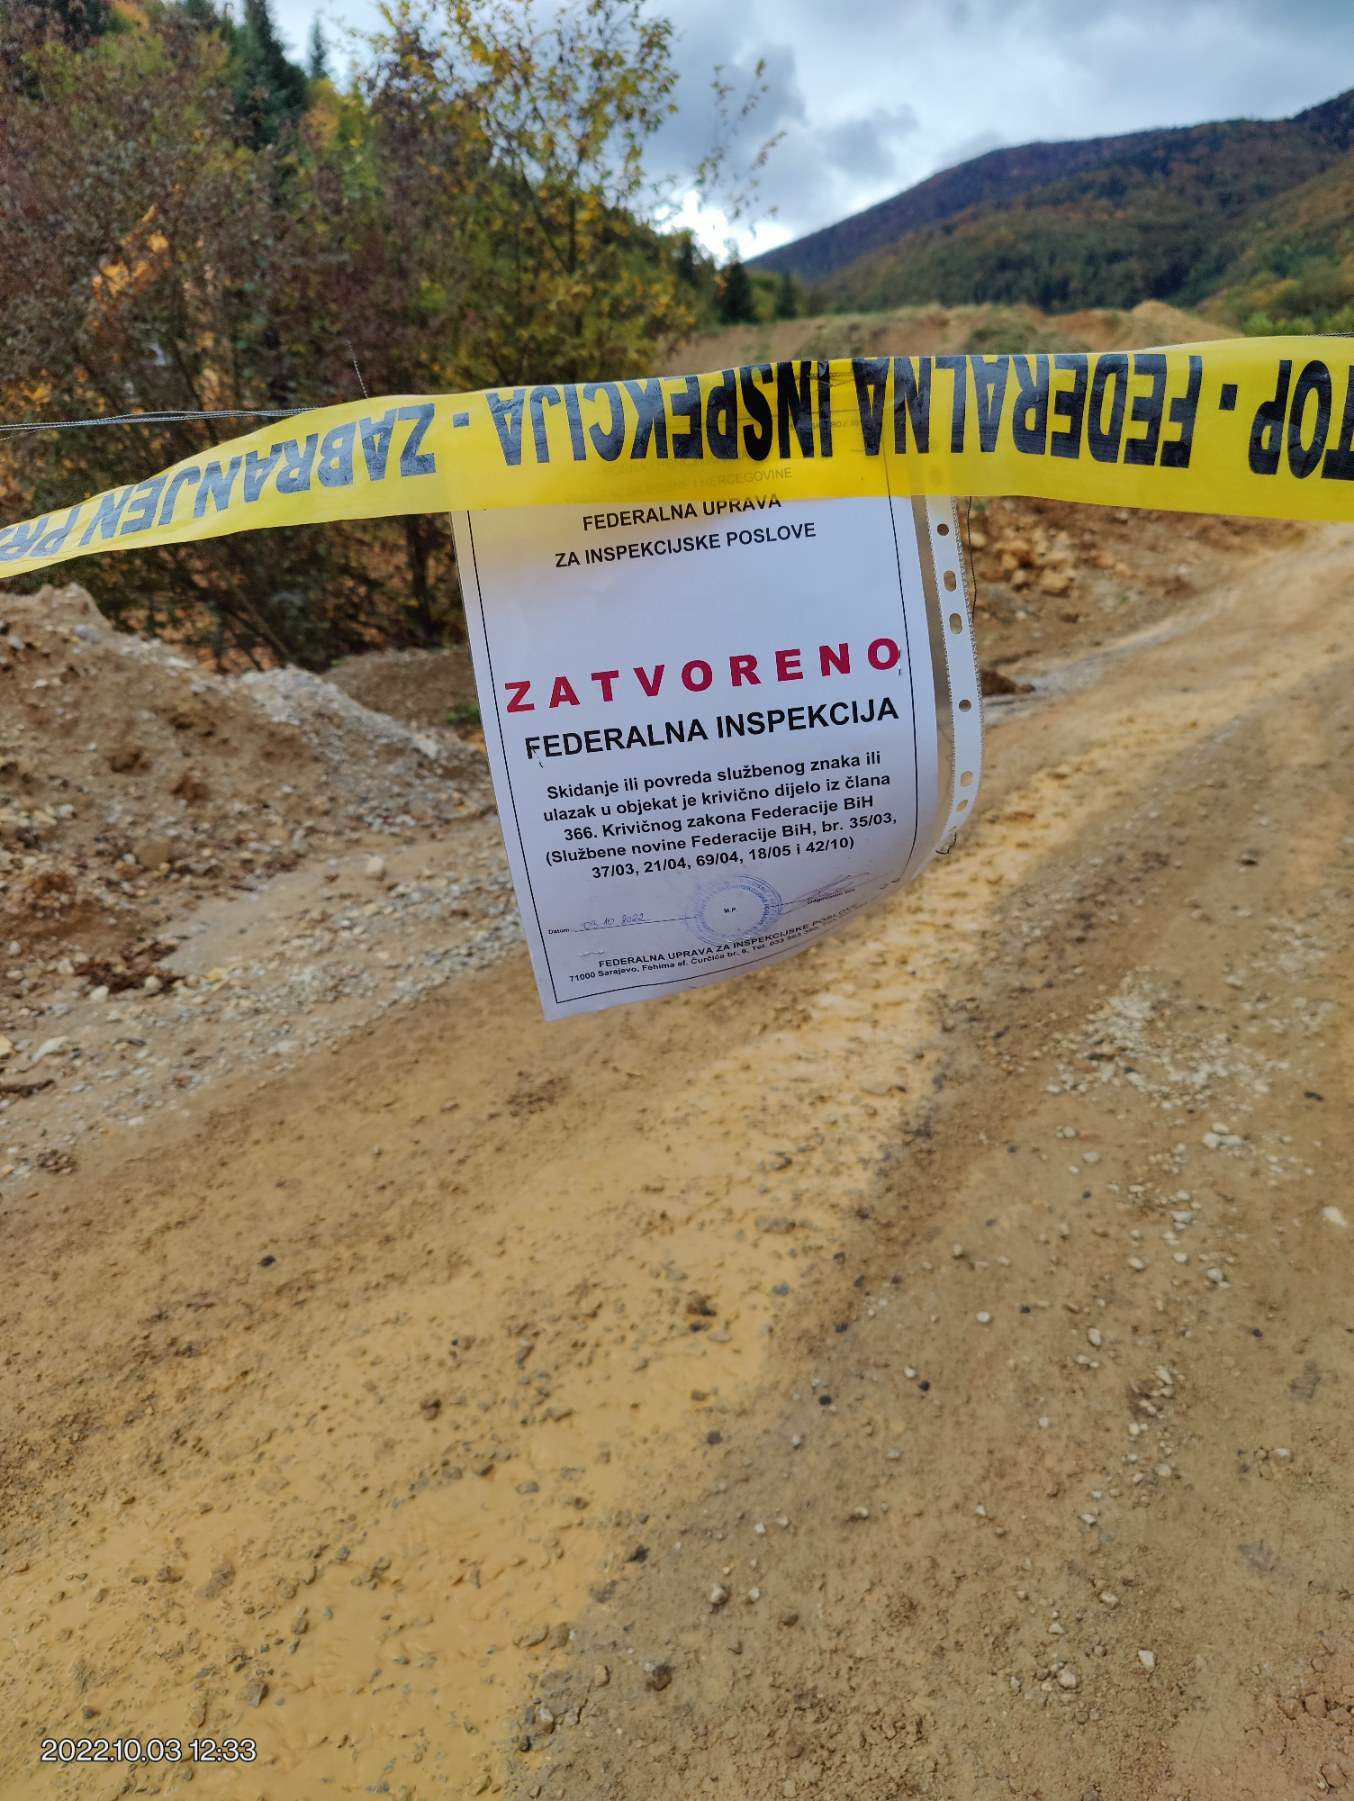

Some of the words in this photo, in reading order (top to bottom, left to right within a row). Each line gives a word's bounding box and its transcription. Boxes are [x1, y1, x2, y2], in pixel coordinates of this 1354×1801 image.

[487, 360, 834, 466] INSPEKCIJA
[851, 354, 1203, 468] FEDERALNA
[80, 403, 436, 546] ZABRANJEN
[0, 504, 82, 561] PR
[582, 502, 698, 531] FEDERALNA
[703, 493, 782, 516] UPRAVA
[555, 552, 580, 568] ZA
[585, 533, 721, 564] INSPEKCIJSKE
[726, 522, 817, 547] POSLOVE
[504, 637, 900, 712] ZATVORENO
[525, 718, 709, 759] FEDERALNA
[716, 697, 900, 738] INSPEKCIJA
[543, 804, 596, 822] ulazak
[601, 805, 611, 816] u
[616, 796, 678, 816] objekat
[682, 794, 697, 810] je
[702, 787, 769, 805] krivično
[774, 781, 821, 799] dijelo
[826, 778, 840, 792] iz
[845, 774, 891, 789] člana
[547, 780, 619, 800] Skidanje
[624, 777, 639, 792] ili
[644, 770, 712, 792] povreda
[717, 762, 805, 782] službenog
[810, 755, 861, 772] znaka
[866, 751, 881, 766] ili
[546, 845, 626, 867] (Službene
[631, 839, 687, 856] novine
[691, 828, 777, 848] Federacije
[782, 822, 817, 837] BiH,
[822, 820, 843, 833] br.
[849, 812, 897, 829] 35/03,
[564, 827, 597, 841] 366.
[602, 819, 682, 838] Krivičnog
[687, 812, 746, 828] zakona
[751, 800, 838, 821] Federacije
[844, 795, 874, 811] BiH
[592, 863, 640, 879] 37/03,
[644, 856, 691, 874] 21/04,
[696, 851, 744, 867] 69/04,
[749, 845, 791, 861] 18/05
[796, 843, 801, 854] i
[806, 836, 854, 854] 42/10)
[598, 953, 665, 968] FEDERALNA
[668, 947, 713, 960] UPRAVA
[716, 945, 730, 953] ZA
[733, 924, 810, 948] INSPEKCIJSKE
[569, 972, 595, 982] 71000
